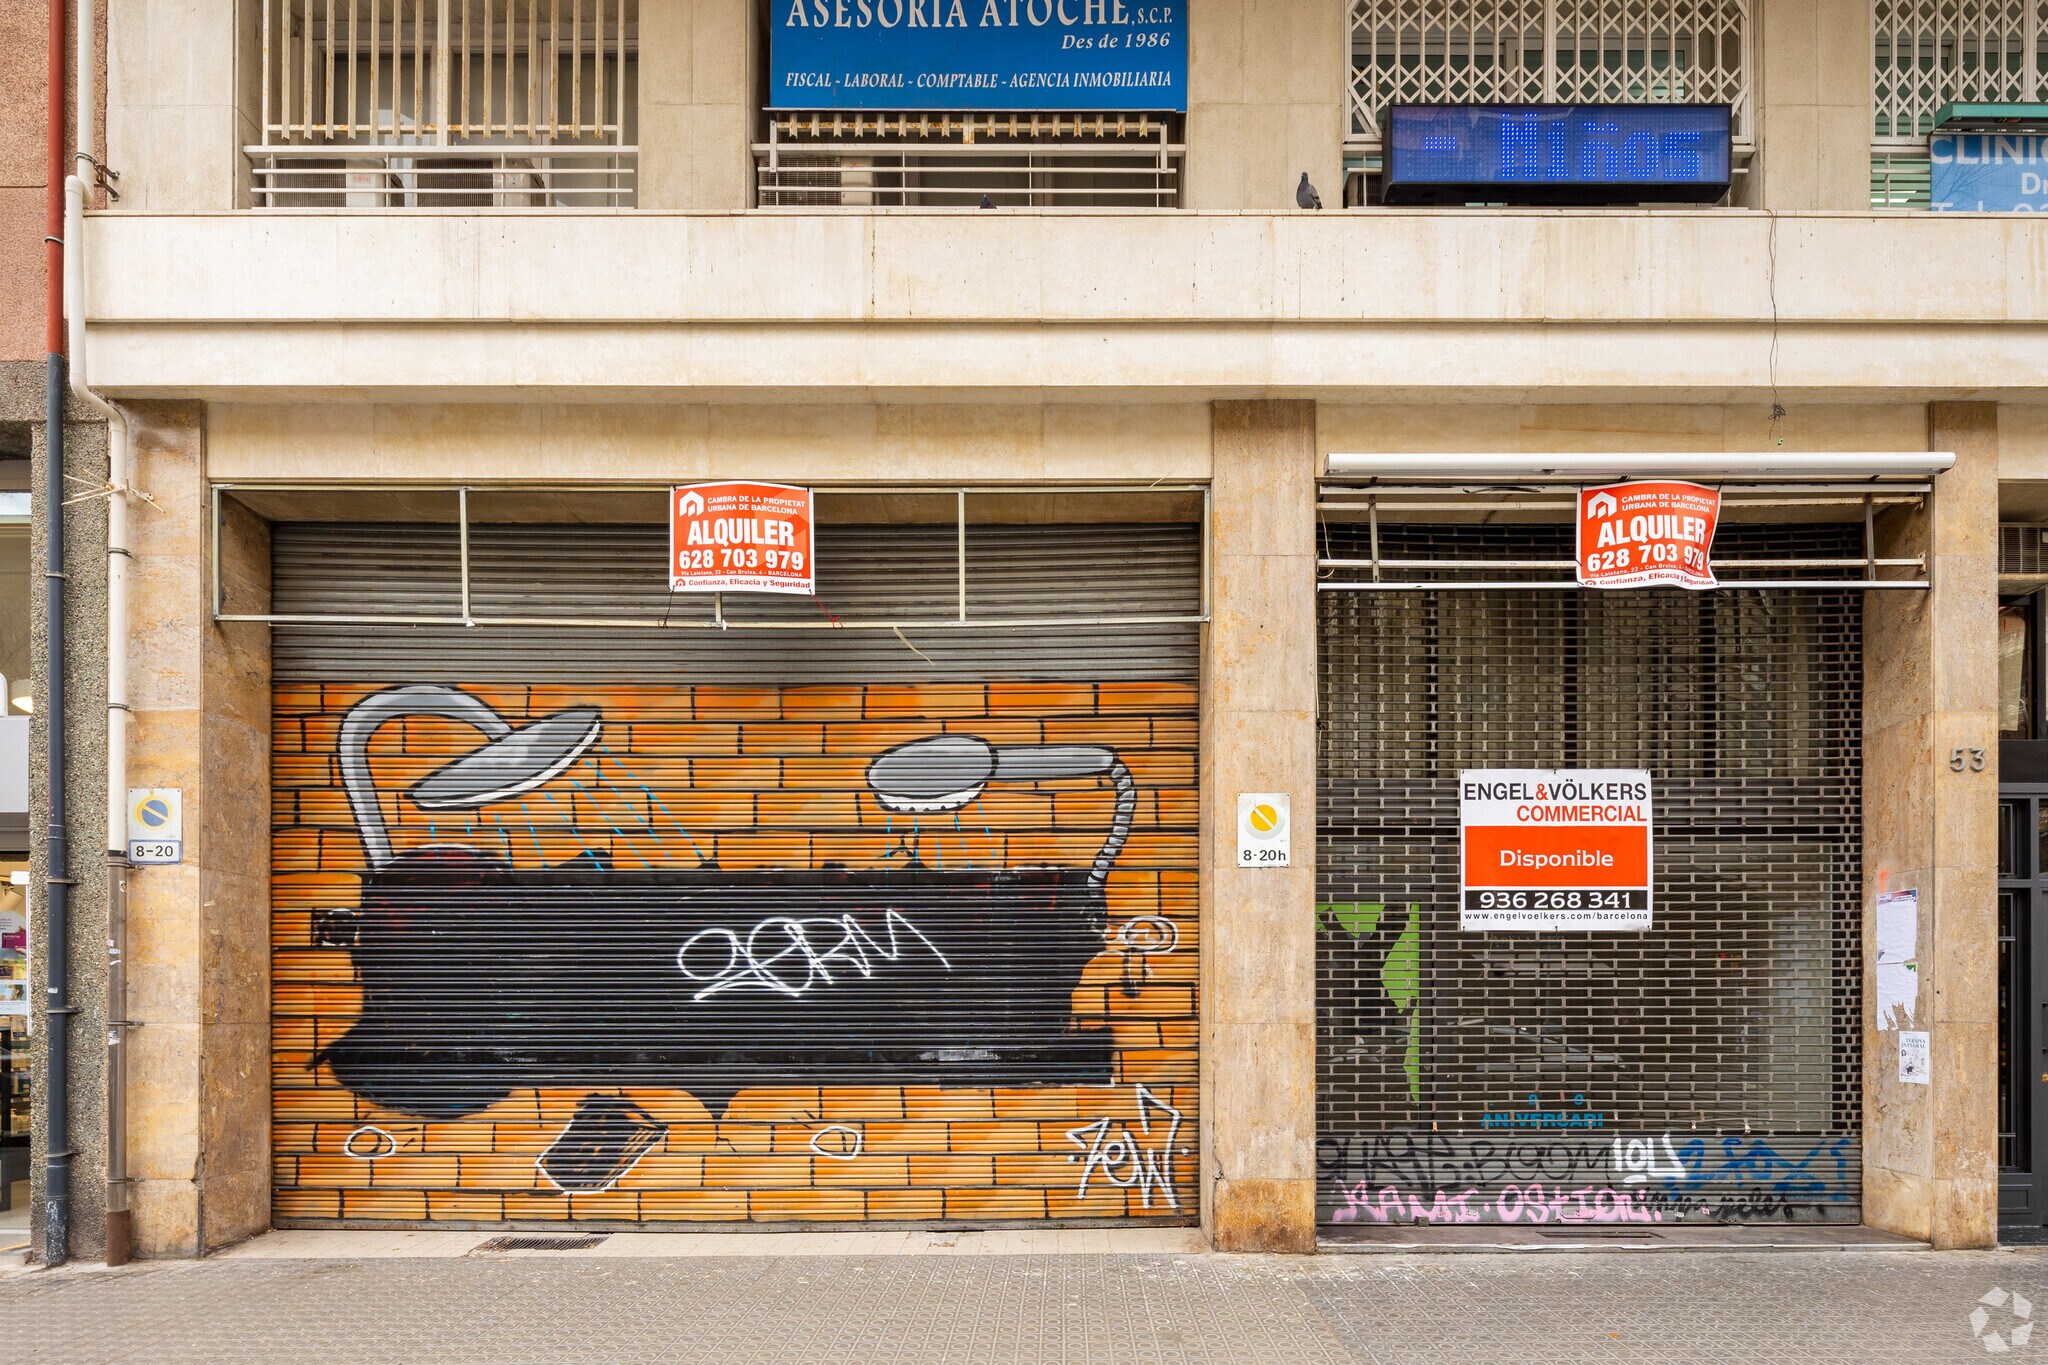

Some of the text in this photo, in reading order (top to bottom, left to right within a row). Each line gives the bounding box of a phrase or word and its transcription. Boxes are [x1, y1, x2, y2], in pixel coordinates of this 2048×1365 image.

[786, 0, 967, 28] ASESORIA
[1061, 32, 1171, 50] Des de 1986
[785, 72, 832, 87] FISCAL
[843, 73, 905, 88] LABORAL
[916, 73, 998, 88] COMPTABLE
[1009, 73, 1070, 88] AGENCIA
[1072, 71, 1172, 88] INMOBILIARIA
[1931, 135, 2048, 165] CLINI
[707, 495, 737, 504] CAMBRA
[763, 497, 805, 507] PROPIETAT
[1621, 493, 1657, 503] CAMBRA
[1682, 494, 1716, 506] PROPIETAT
[1621, 502, 1657, 511] URBANA
[1671, 502, 1710, 513] BARCELONA
[707, 504, 737, 512] URBANA
[751, 504, 798, 515] BARCELONA
[687, 518, 795, 547] ALQUILER
[1597, 514, 1706, 548] ALQUILER
[679, 548, 804, 571] 628 703 979
[1587, 543, 1704, 572] 628 703 979
[688, 579, 728, 587] Confianza,
[770, 579, 811, 589] Seguridad
[1599, 576, 1646, 585] Confianza,
[1648, 572, 1680, 580] Eficacia
[1683, 576, 1714, 585] Seguridad
[1950, 747, 1986, 772] 53
[1464, 779, 1647, 801] ENGEL&VÖLKERS
[1516, 805, 1647, 822] COMMERCIAL
[1499, 849, 1614, 869] Disponible
[1479, 892, 1631, 909] 936 268 341
[1464, 912, 1648, 921] www.engelvoelkers.com/barcelona
